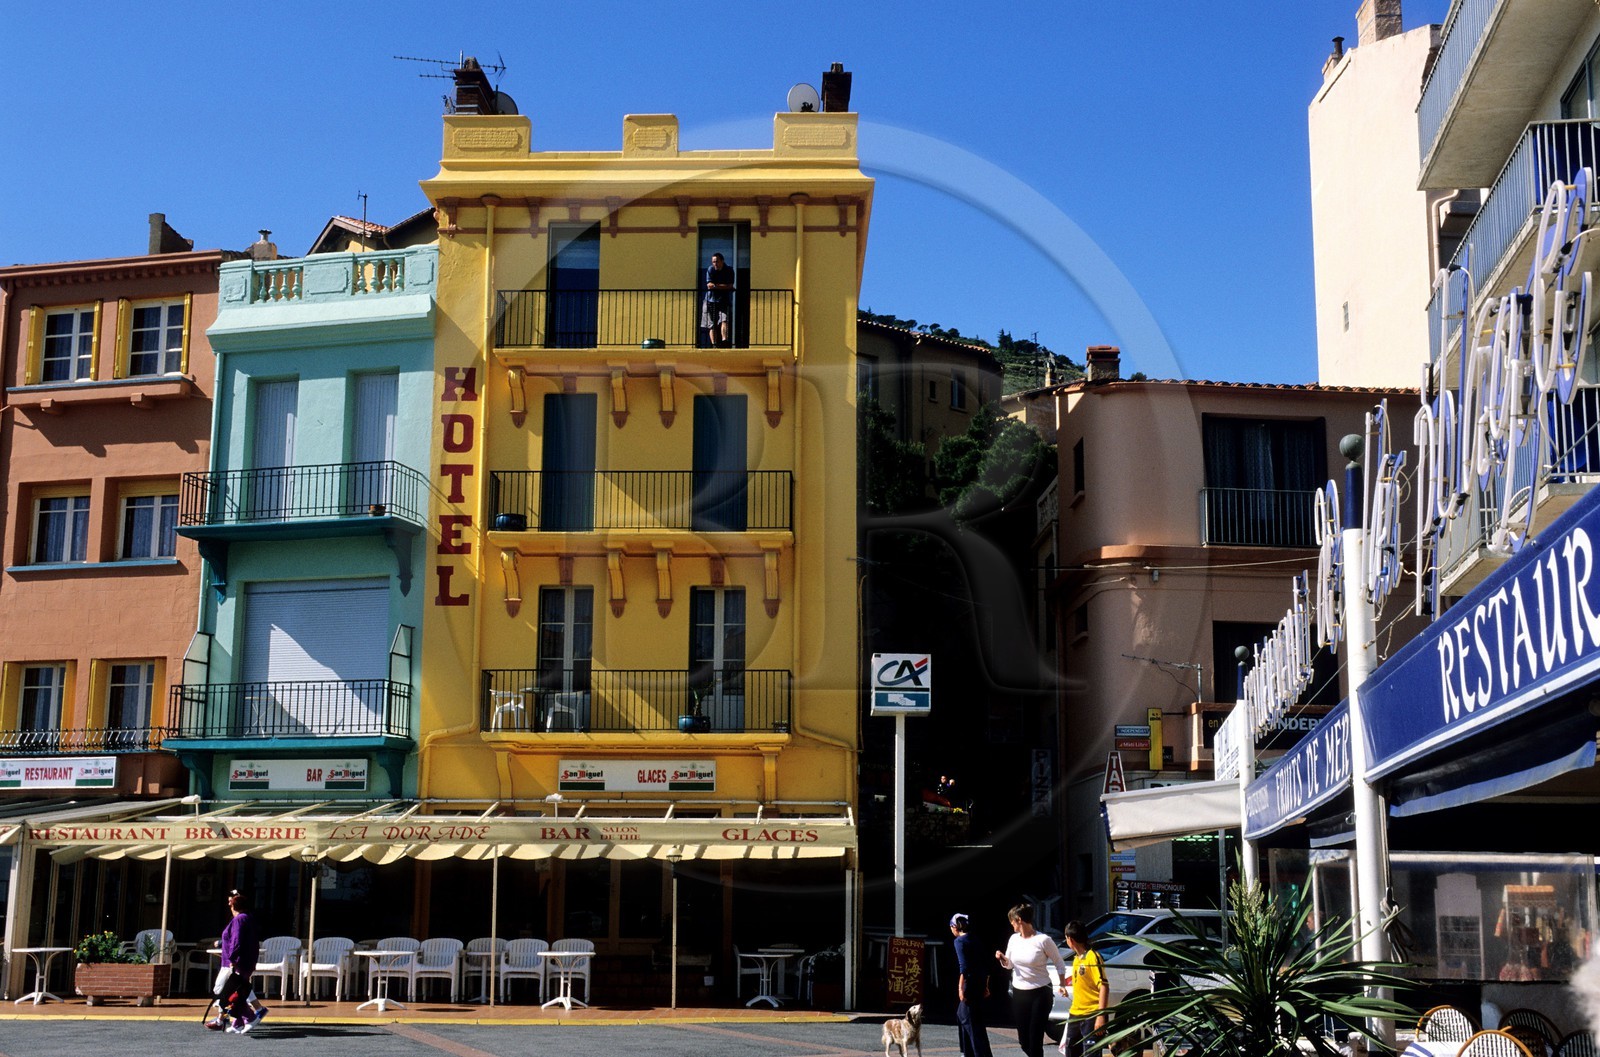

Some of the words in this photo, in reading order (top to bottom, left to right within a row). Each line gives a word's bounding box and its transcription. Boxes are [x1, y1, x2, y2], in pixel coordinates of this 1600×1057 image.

[434, 366, 478, 606] HOTEL
[1437, 527, 1600, 724] RESTAUR
[92, 766, 114, 777] Miguel
[1275, 752, 1303, 817] FRUITS
[1305, 737, 1319, 799] DE
[1325, 712, 1350, 789] MER
[25, 767, 73, 781] RESTAURANT
[232, 769, 247, 779] San
[246, 769, 269, 779] Miguel
[306, 768, 323, 782] BAR
[327, 769, 343, 779] San
[342, 769, 365, 779] Miguel
[561, 769, 578, 780] San
[577, 769, 603, 780] Miguel
[637, 769, 667, 784] GLACES
[671, 770, 688, 780] San
[687, 770, 714, 780] Miguel
[29, 827, 170, 841] RESTAURANT
[185, 827, 307, 840] BRASSERIE
[328, 824, 368, 840] LA
[383, 825, 490, 842] DORADE
[540, 827, 592, 840] BAR
[722, 828, 819, 842] GLACES
[889, 957, 922, 978] 上海
[888, 974, 920, 997] 酒家
